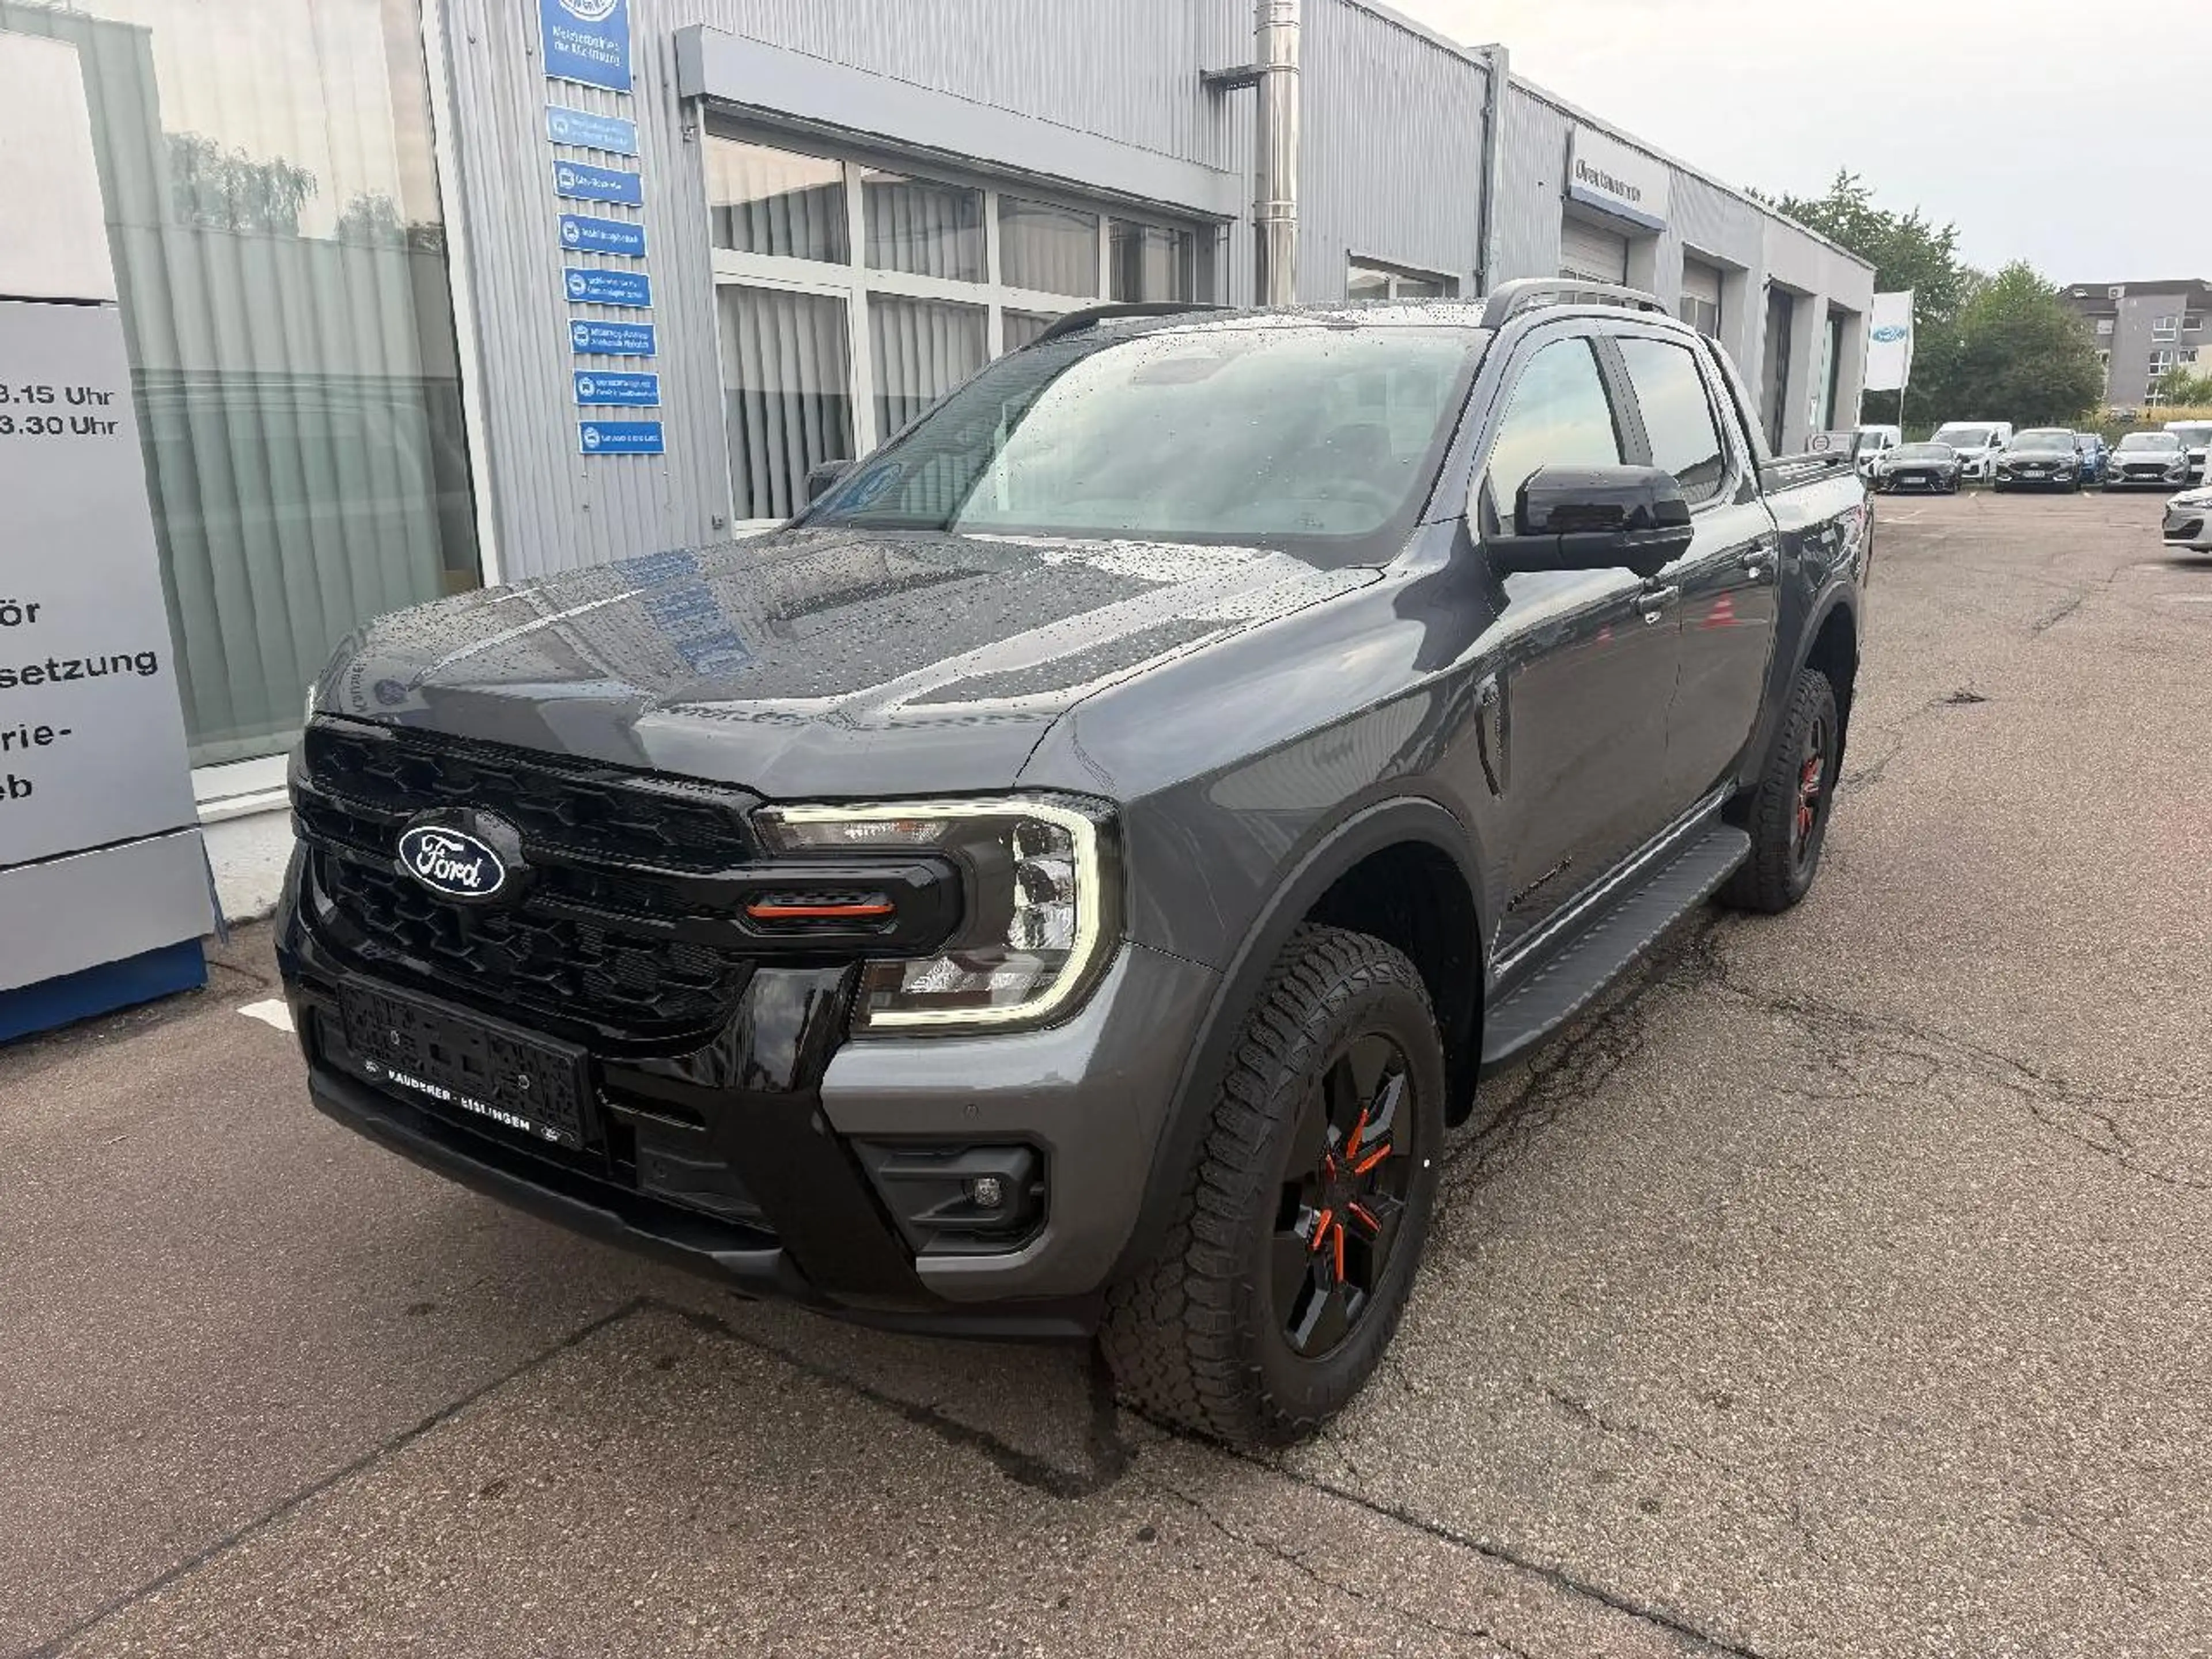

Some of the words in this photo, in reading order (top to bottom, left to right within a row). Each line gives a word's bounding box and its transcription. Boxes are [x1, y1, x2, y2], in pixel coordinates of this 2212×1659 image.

[65, 387, 115, 405] Uhr
[69, 416, 118, 434] Uhr
[0, 651, 158, 688] setzung
[1, 724, 72, 751] rie-
[416, 834, 483, 888] Ford
